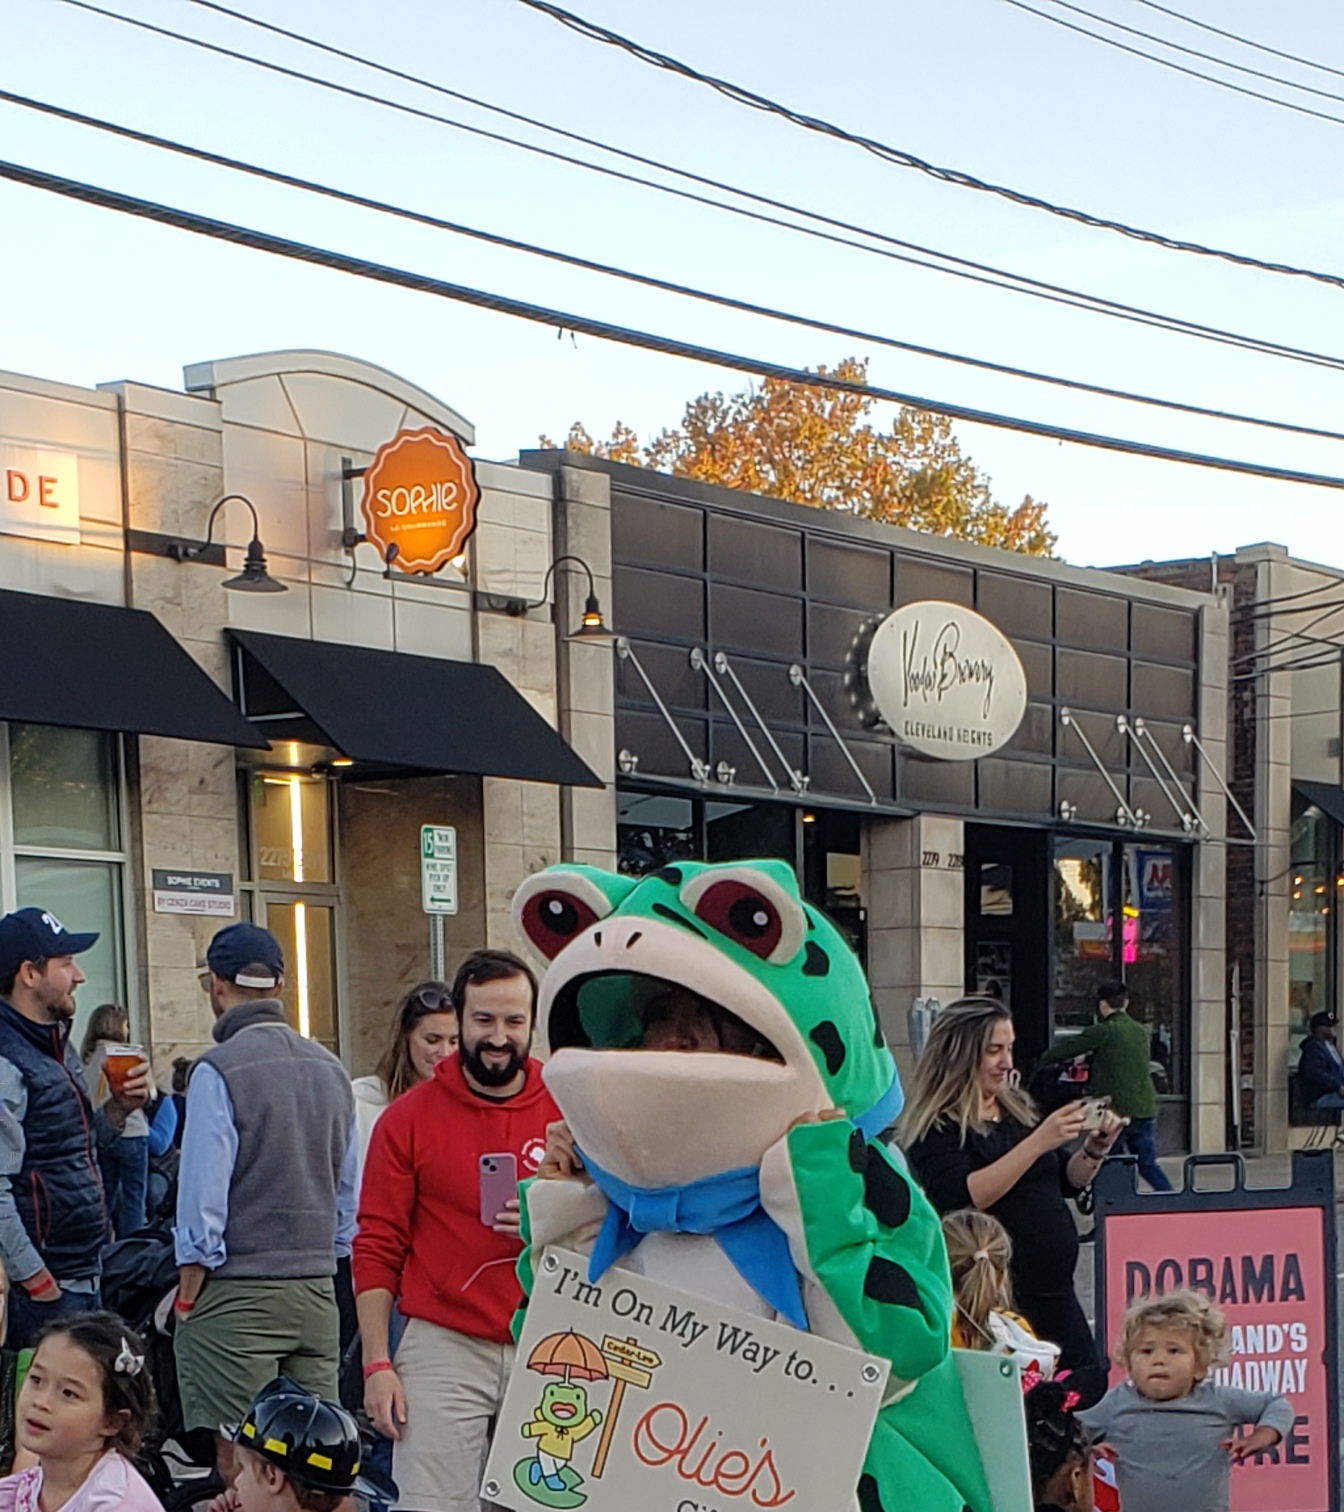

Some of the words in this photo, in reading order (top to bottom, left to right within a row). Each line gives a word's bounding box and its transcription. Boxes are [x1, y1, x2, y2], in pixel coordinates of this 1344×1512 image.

[905, 721, 954, 742] CLEVELAND
[957, 728, 993, 747] HEIGHTS
[424, 831, 434, 854] 15
[1125, 1253, 1305, 1306] DOBAMA
[553, 1268, 602, 1308] I'm
[611, 1288, 655, 1326] On
[659, 1305, 709, 1348] My
[717, 1322, 780, 1374] Way
[633, 1402, 796, 1508] Olie's
